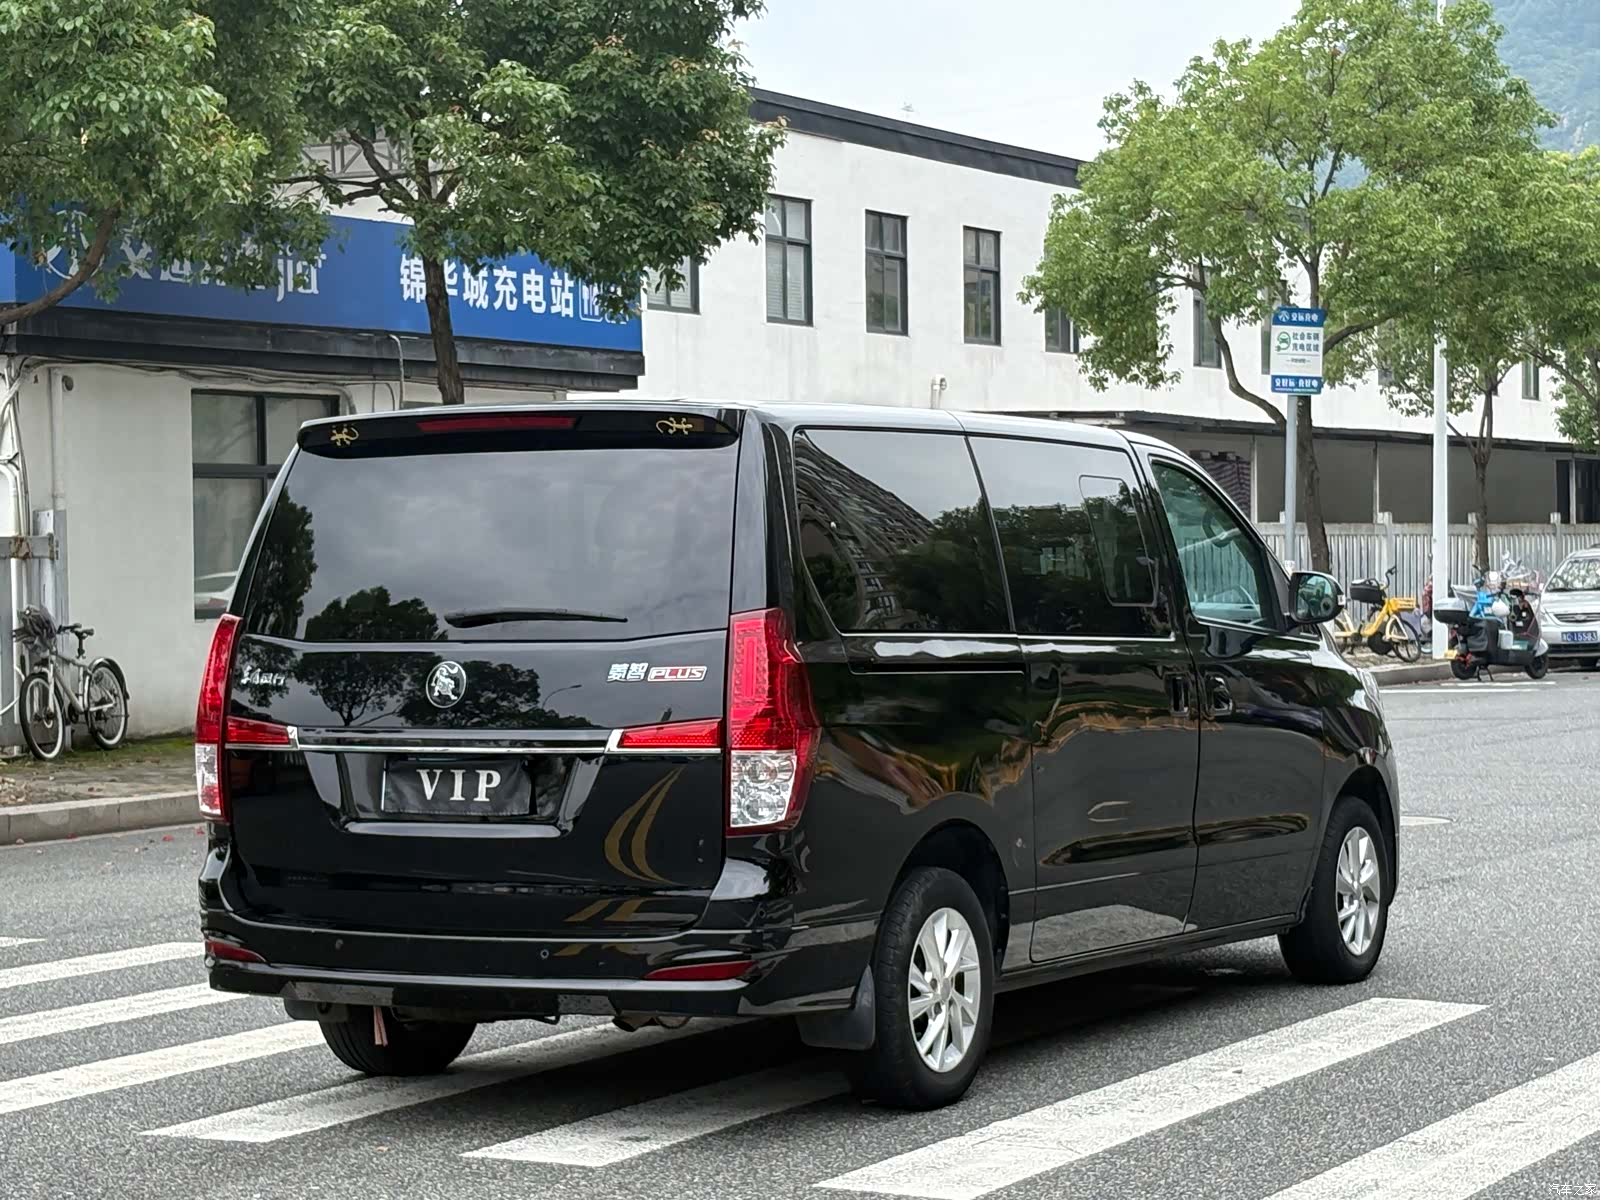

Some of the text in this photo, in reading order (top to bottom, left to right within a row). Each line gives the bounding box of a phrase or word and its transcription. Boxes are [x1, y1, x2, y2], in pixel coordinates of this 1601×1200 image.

[607, 662, 706, 681] 菱智 PLUS
[416, 769, 501, 802] VIP
